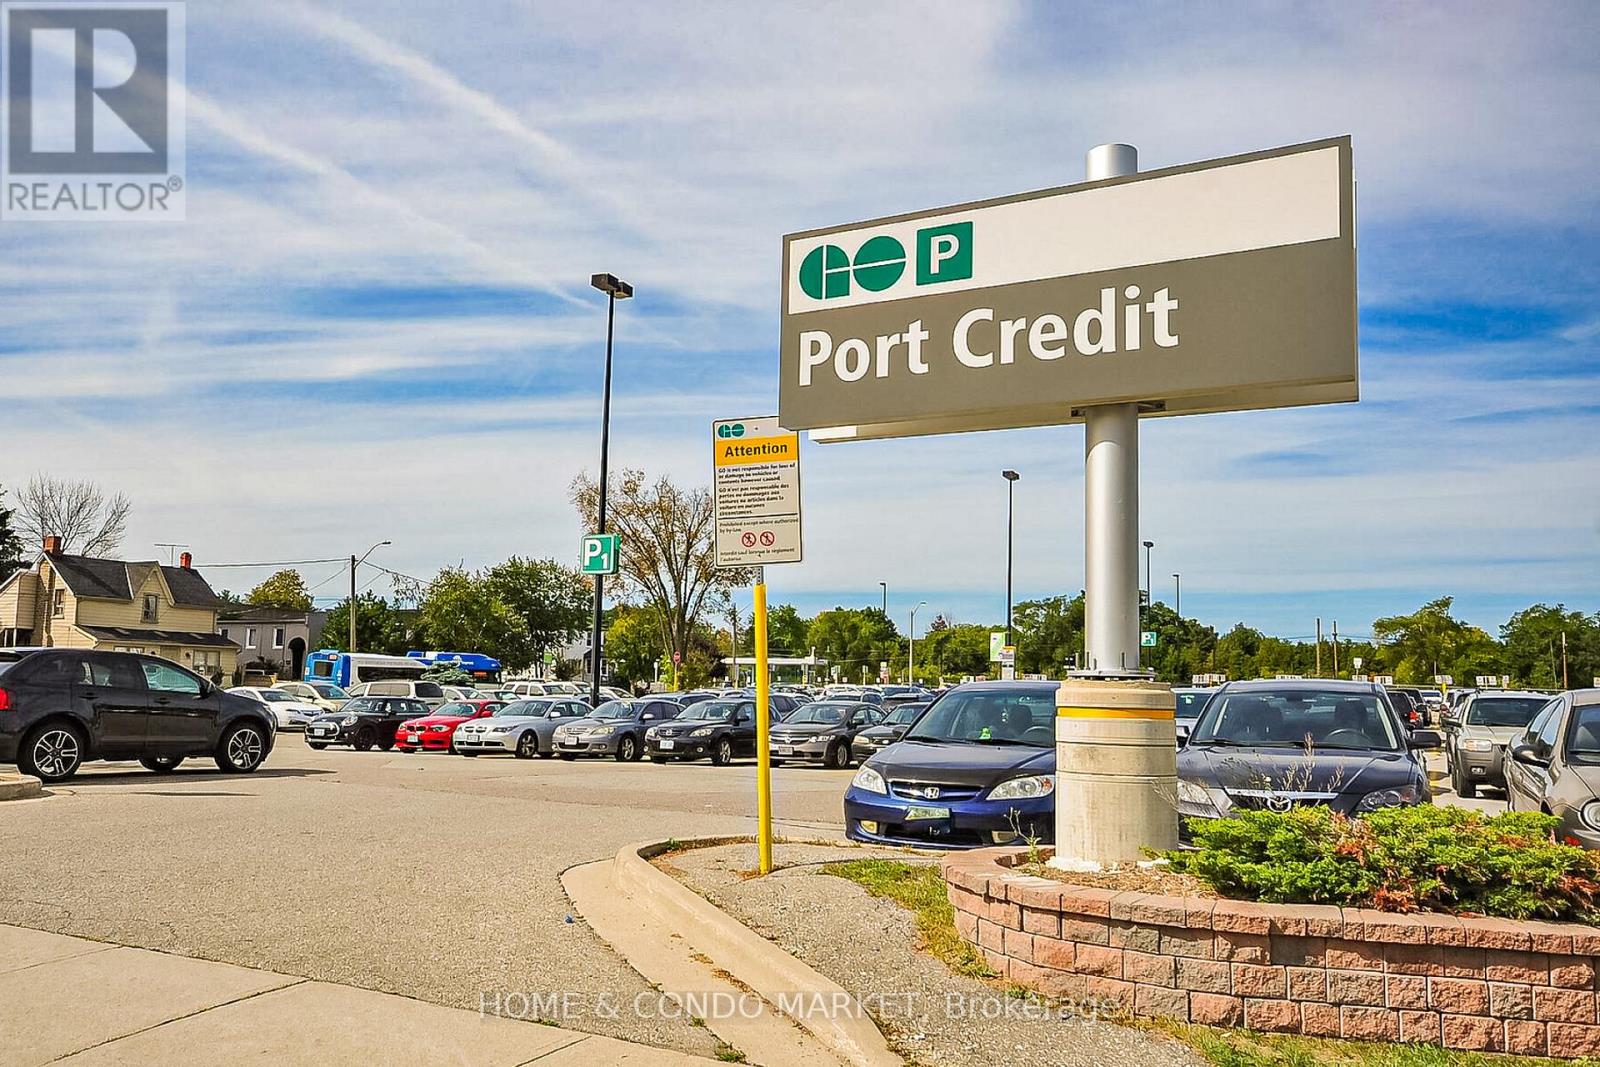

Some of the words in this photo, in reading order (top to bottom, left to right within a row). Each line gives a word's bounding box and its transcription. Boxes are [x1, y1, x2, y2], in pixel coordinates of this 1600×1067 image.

[798, 235, 907, 301] GO
[929, 233, 961, 275] P
[798, 318, 930, 387] Port
[952, 284, 1180, 369] Credit
[717, 423, 745, 438] GO
[724, 442, 788, 458] Attention
